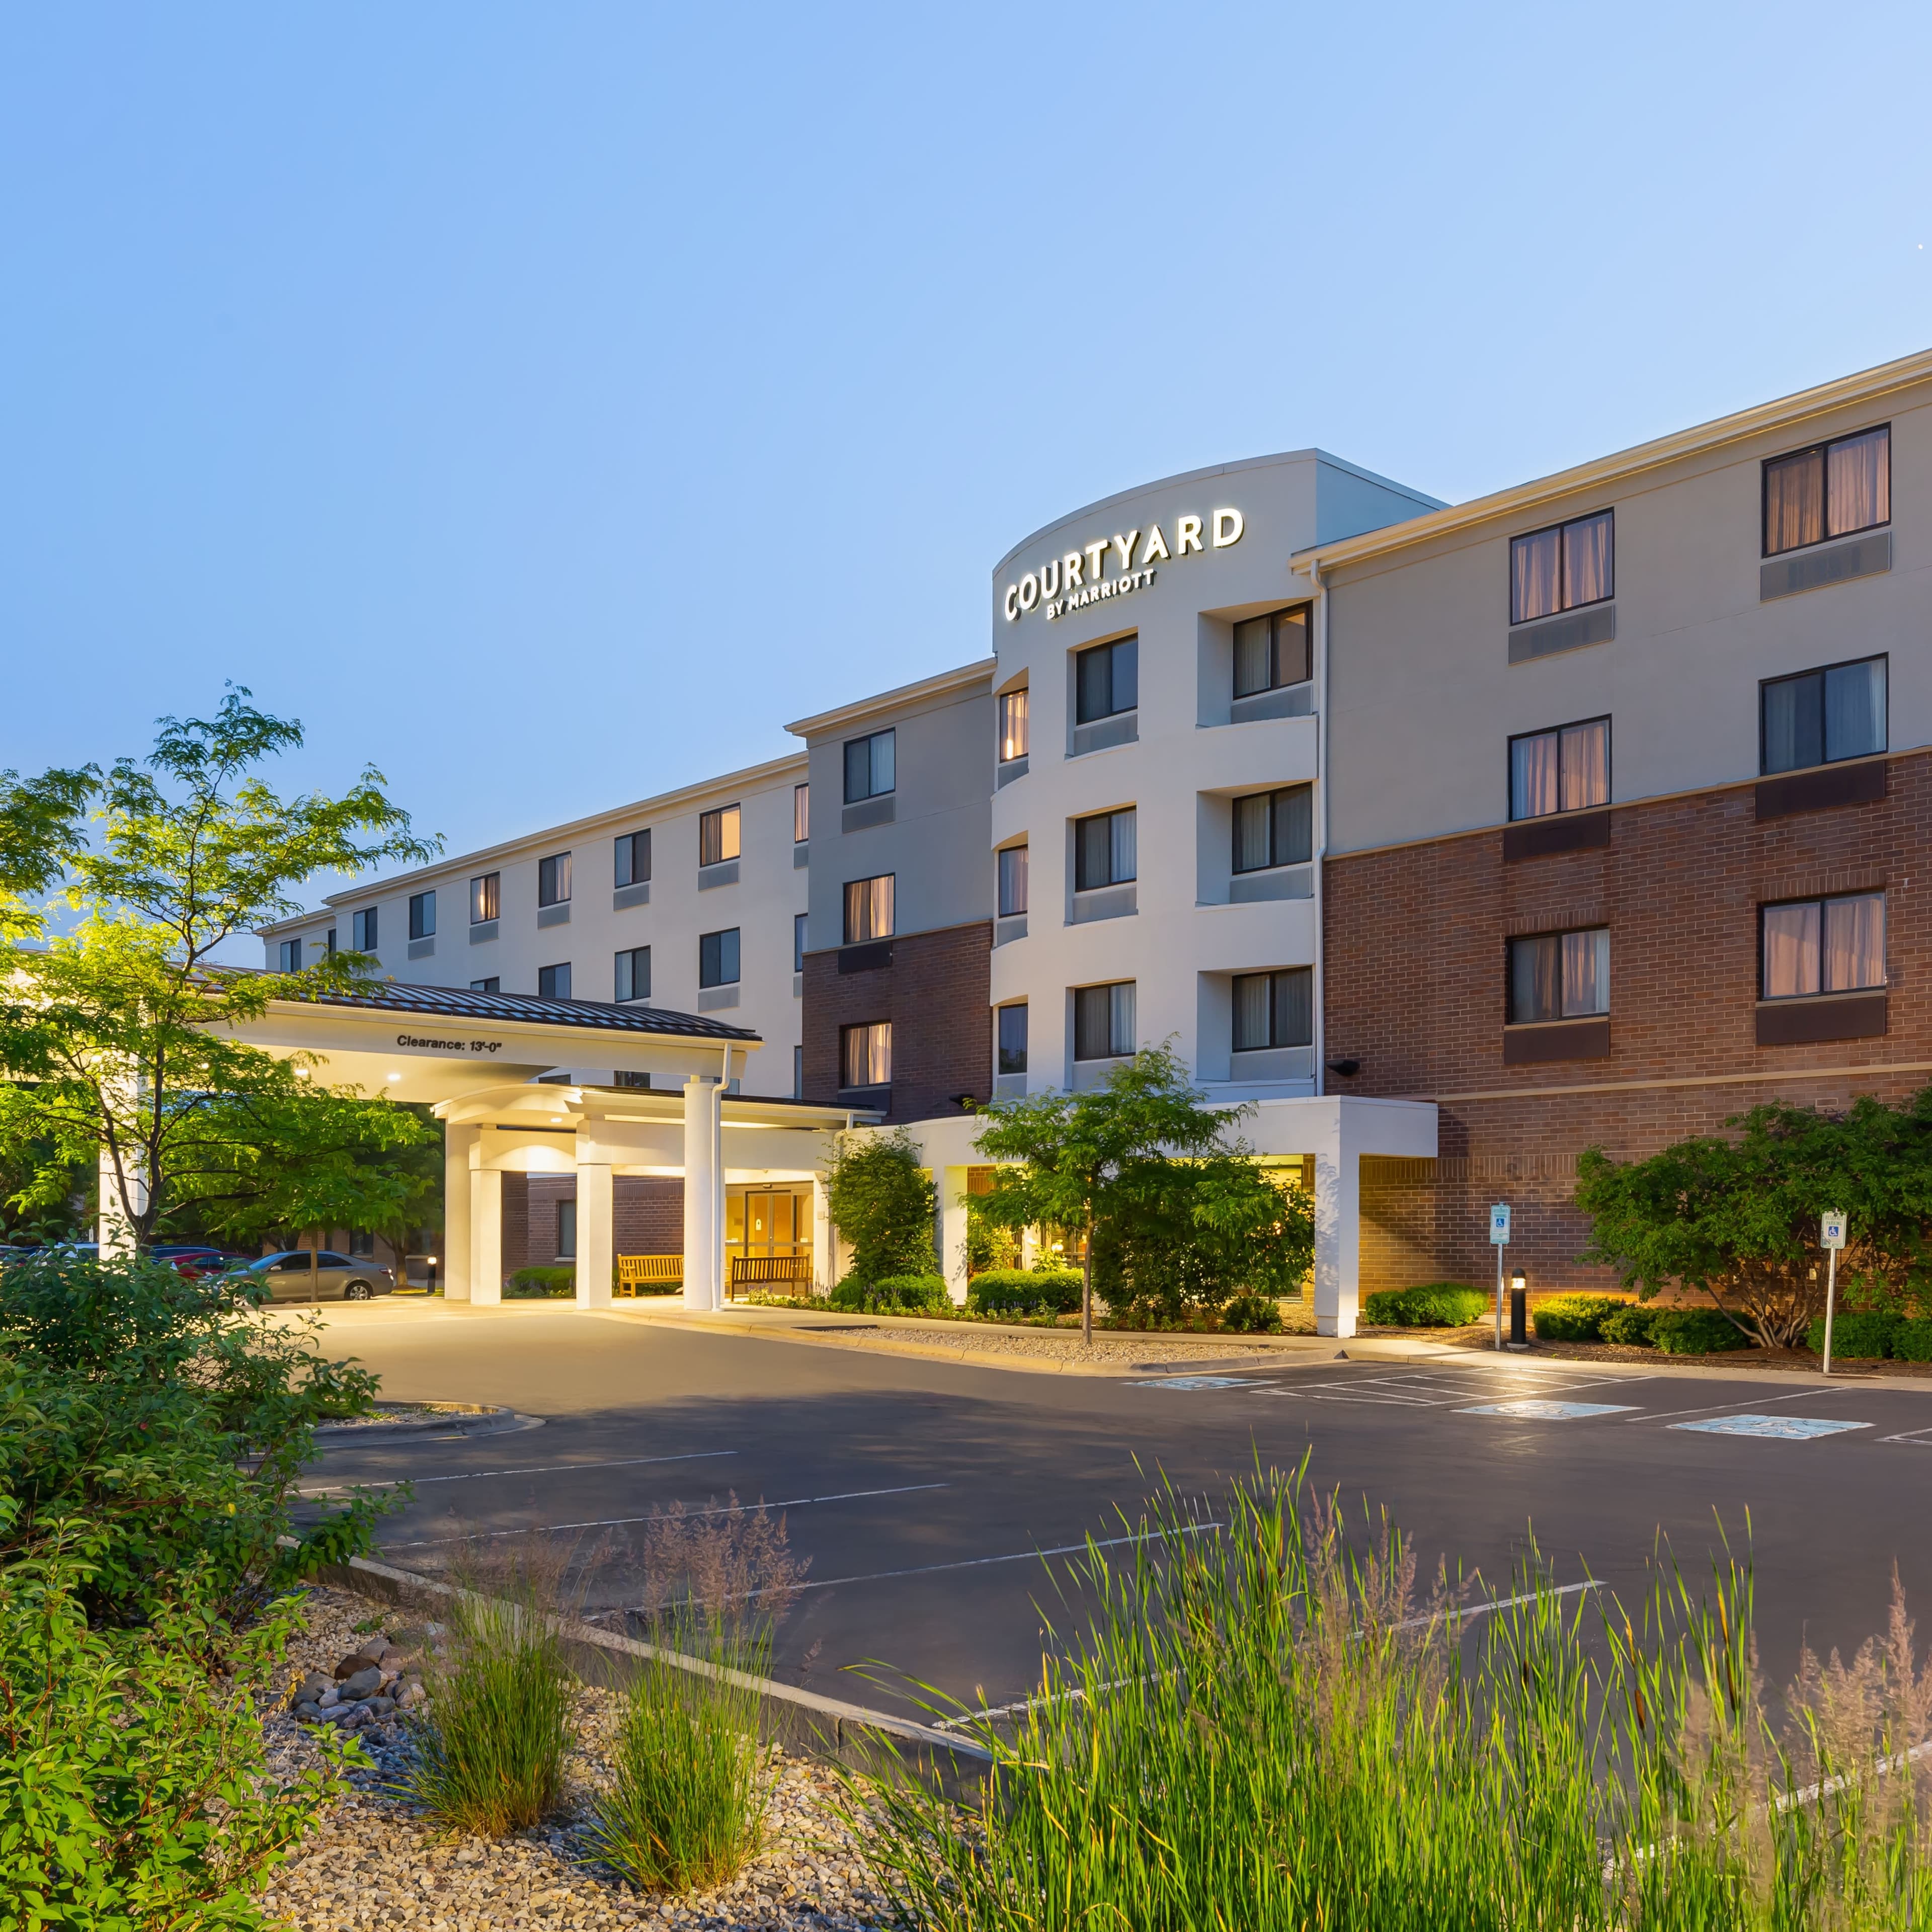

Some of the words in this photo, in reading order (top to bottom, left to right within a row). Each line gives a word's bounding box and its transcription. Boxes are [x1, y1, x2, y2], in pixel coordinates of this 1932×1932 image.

[1005, 508, 1245, 621] COURTYARD
[1046, 599, 1065, 620] BY
[1068, 569, 1155, 611] MARRIOTT
[396, 1034, 465, 1051] Clearance:
